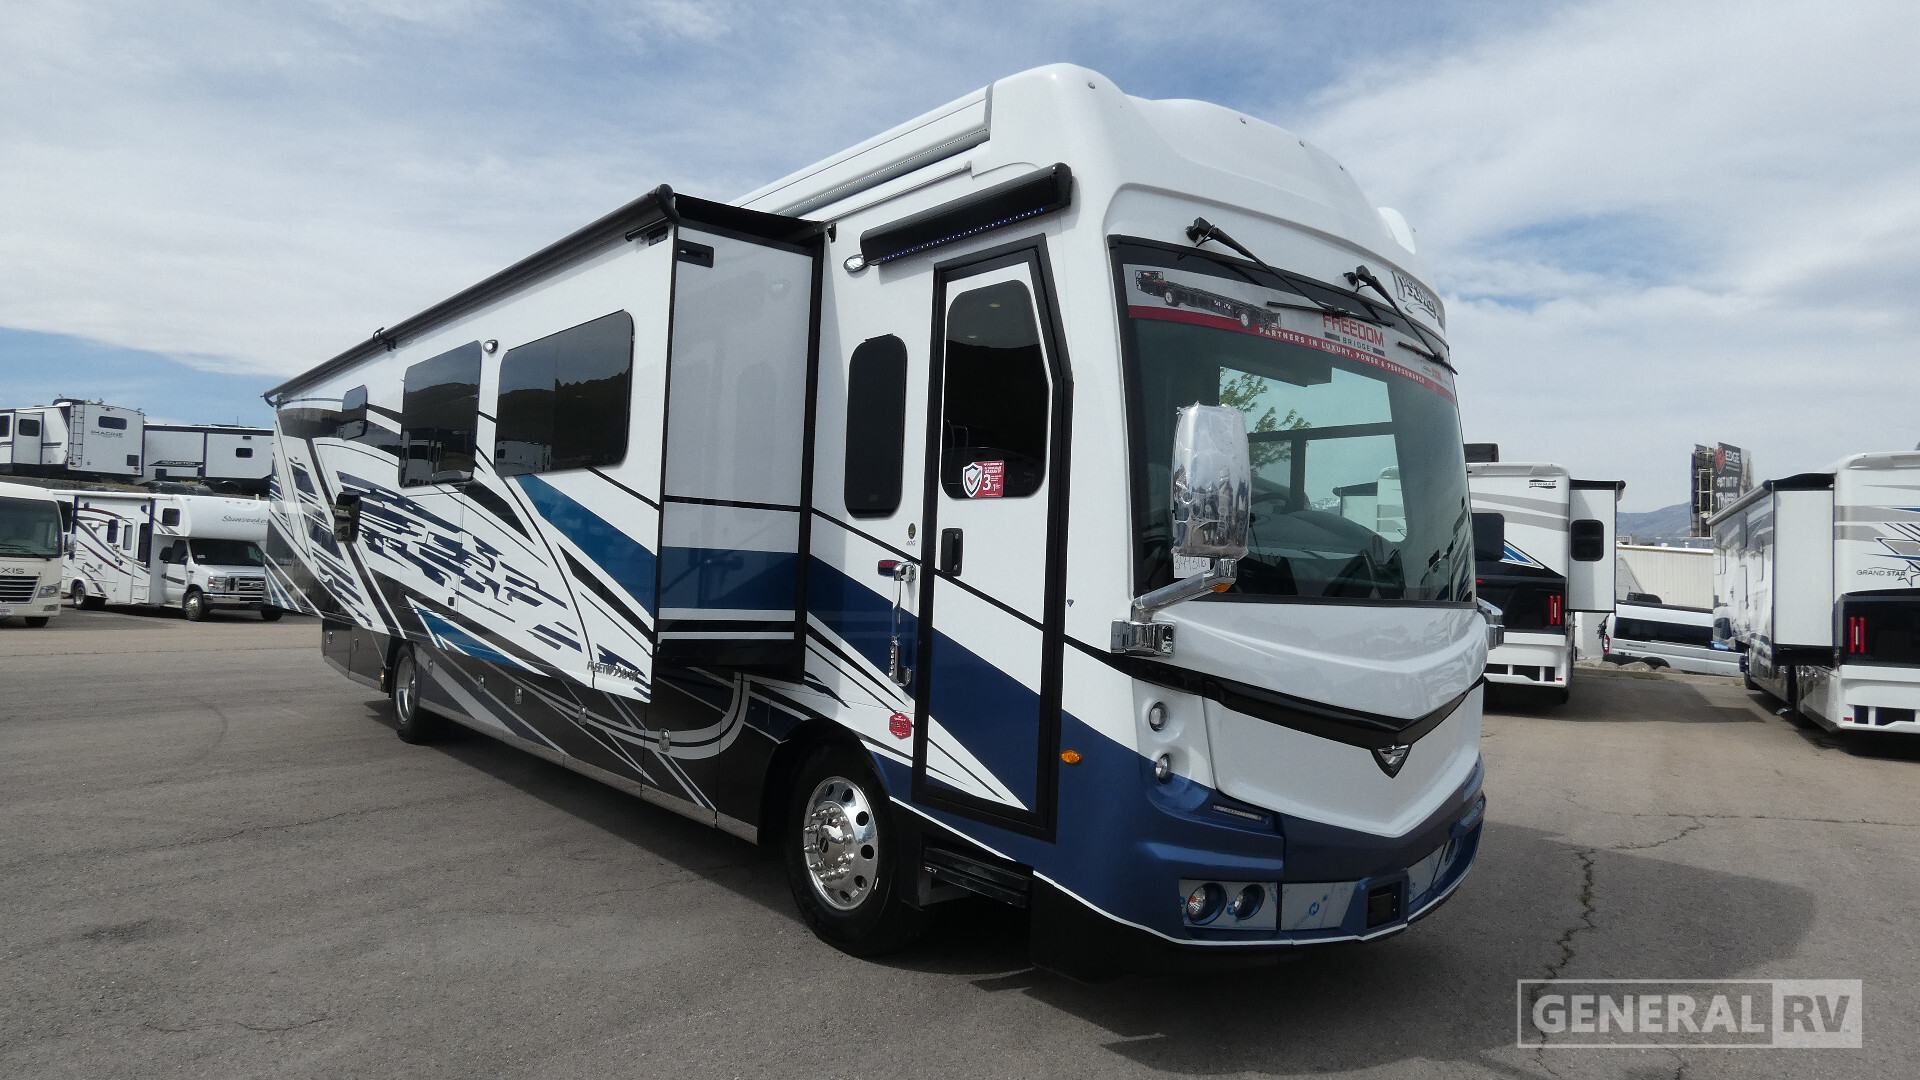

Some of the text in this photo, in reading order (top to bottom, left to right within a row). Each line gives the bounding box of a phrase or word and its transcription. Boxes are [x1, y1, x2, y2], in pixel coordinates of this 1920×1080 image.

[1322, 312, 1384, 347] FREEDOM
[1259, 327, 1305, 344] PARTNERS
[1308, 338, 1318, 347] IN
[1321, 341, 1353, 357] LUXURY,
[1355, 352, 1379, 365] POWER
[1342, 337, 1371, 352] BRIDGE
[982, 474, 991, 491] 3
